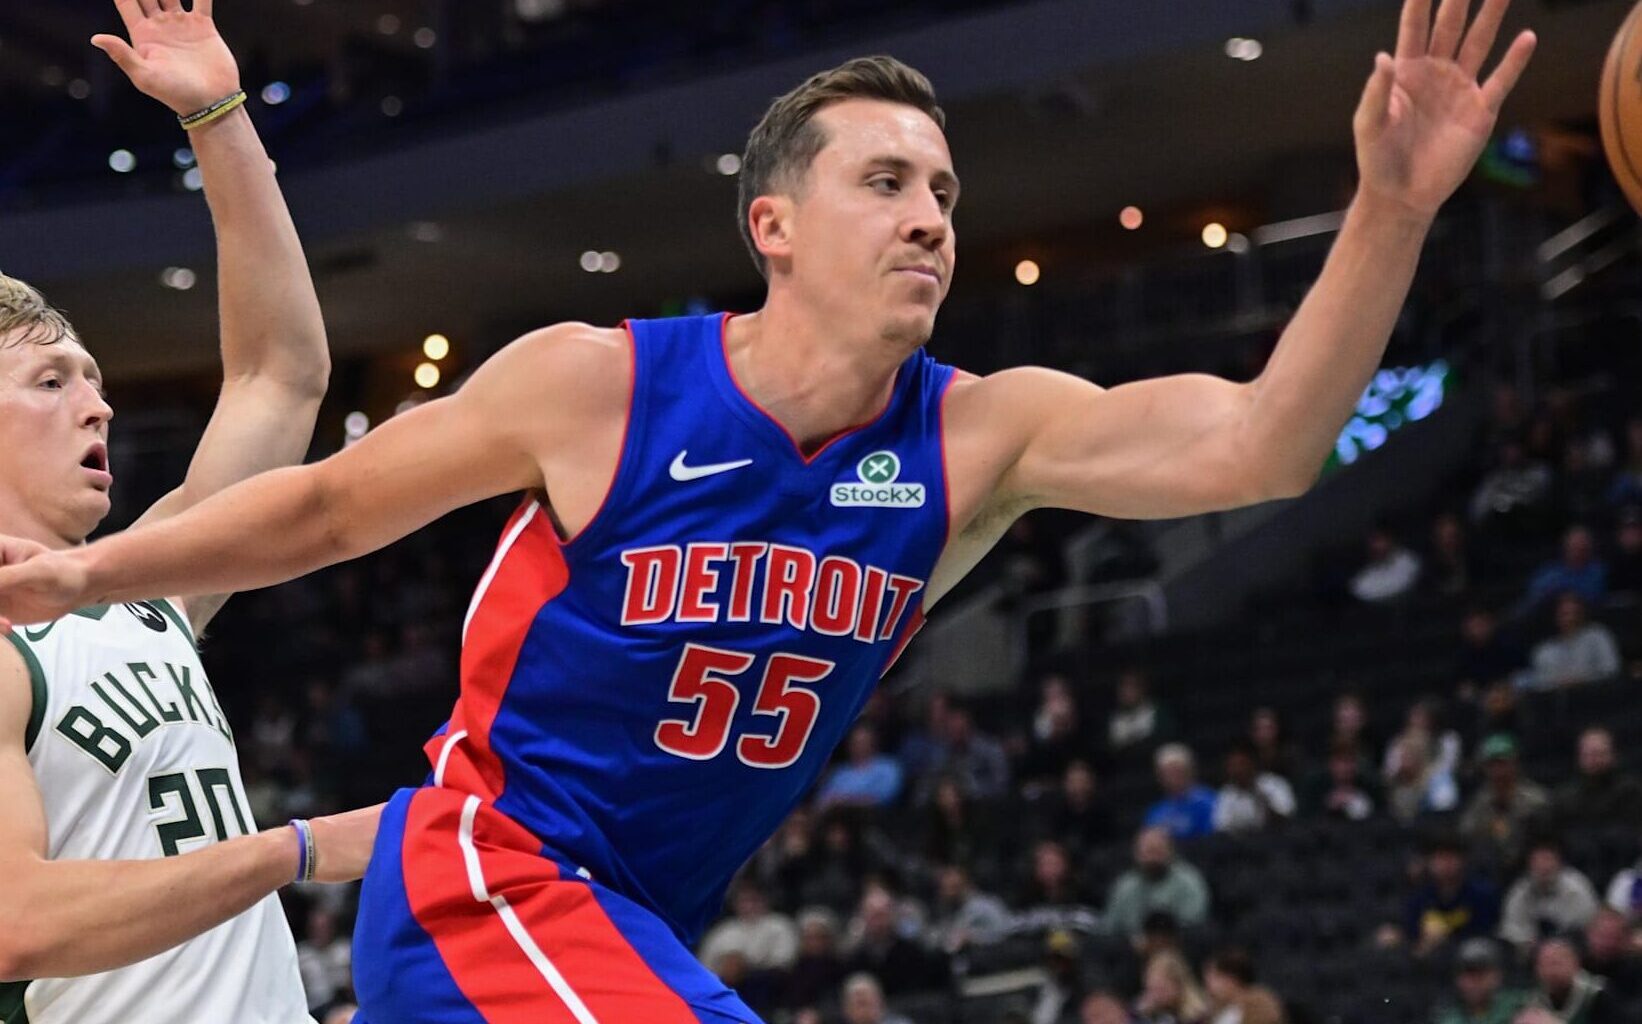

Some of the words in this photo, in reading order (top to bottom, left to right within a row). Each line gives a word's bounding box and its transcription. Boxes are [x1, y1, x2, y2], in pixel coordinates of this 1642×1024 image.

[834, 486, 922, 503] StockX
[621, 541, 924, 644] DETROIT
[653, 643, 835, 769] 55
[147, 768, 251, 857] 20
